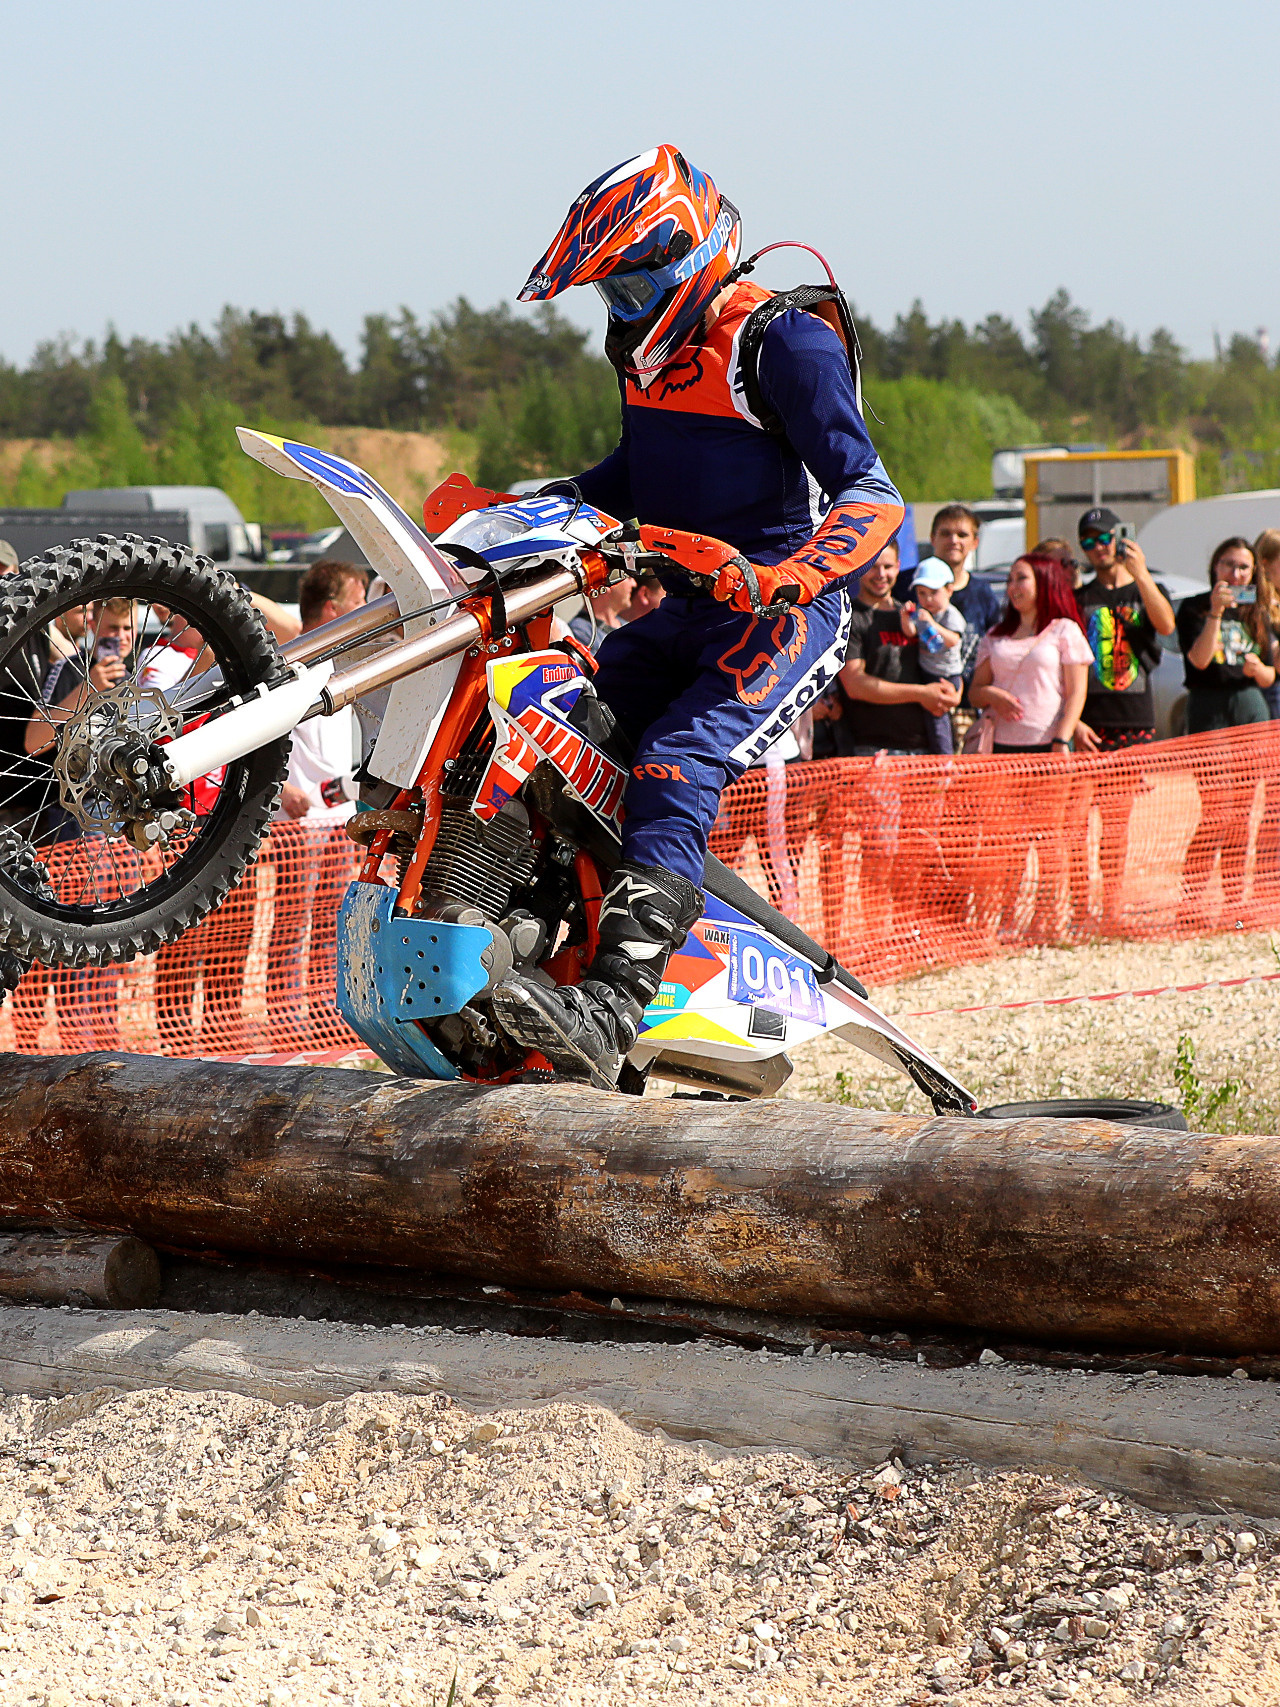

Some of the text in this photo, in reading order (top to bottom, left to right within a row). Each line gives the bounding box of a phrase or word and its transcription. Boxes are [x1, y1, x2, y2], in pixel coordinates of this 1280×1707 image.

[674, 210, 733, 283] 100%
[794, 512, 877, 573] FOX
[542, 666, 578, 684] Enduro
[778, 664, 834, 725] FOX
[516, 706, 628, 828] AVANTI
[631, 763, 690, 784] FOX
[651, 994, 675, 1008] GINE
[658, 983, 676, 994] SHEN
[742, 945, 813, 1007] 001
